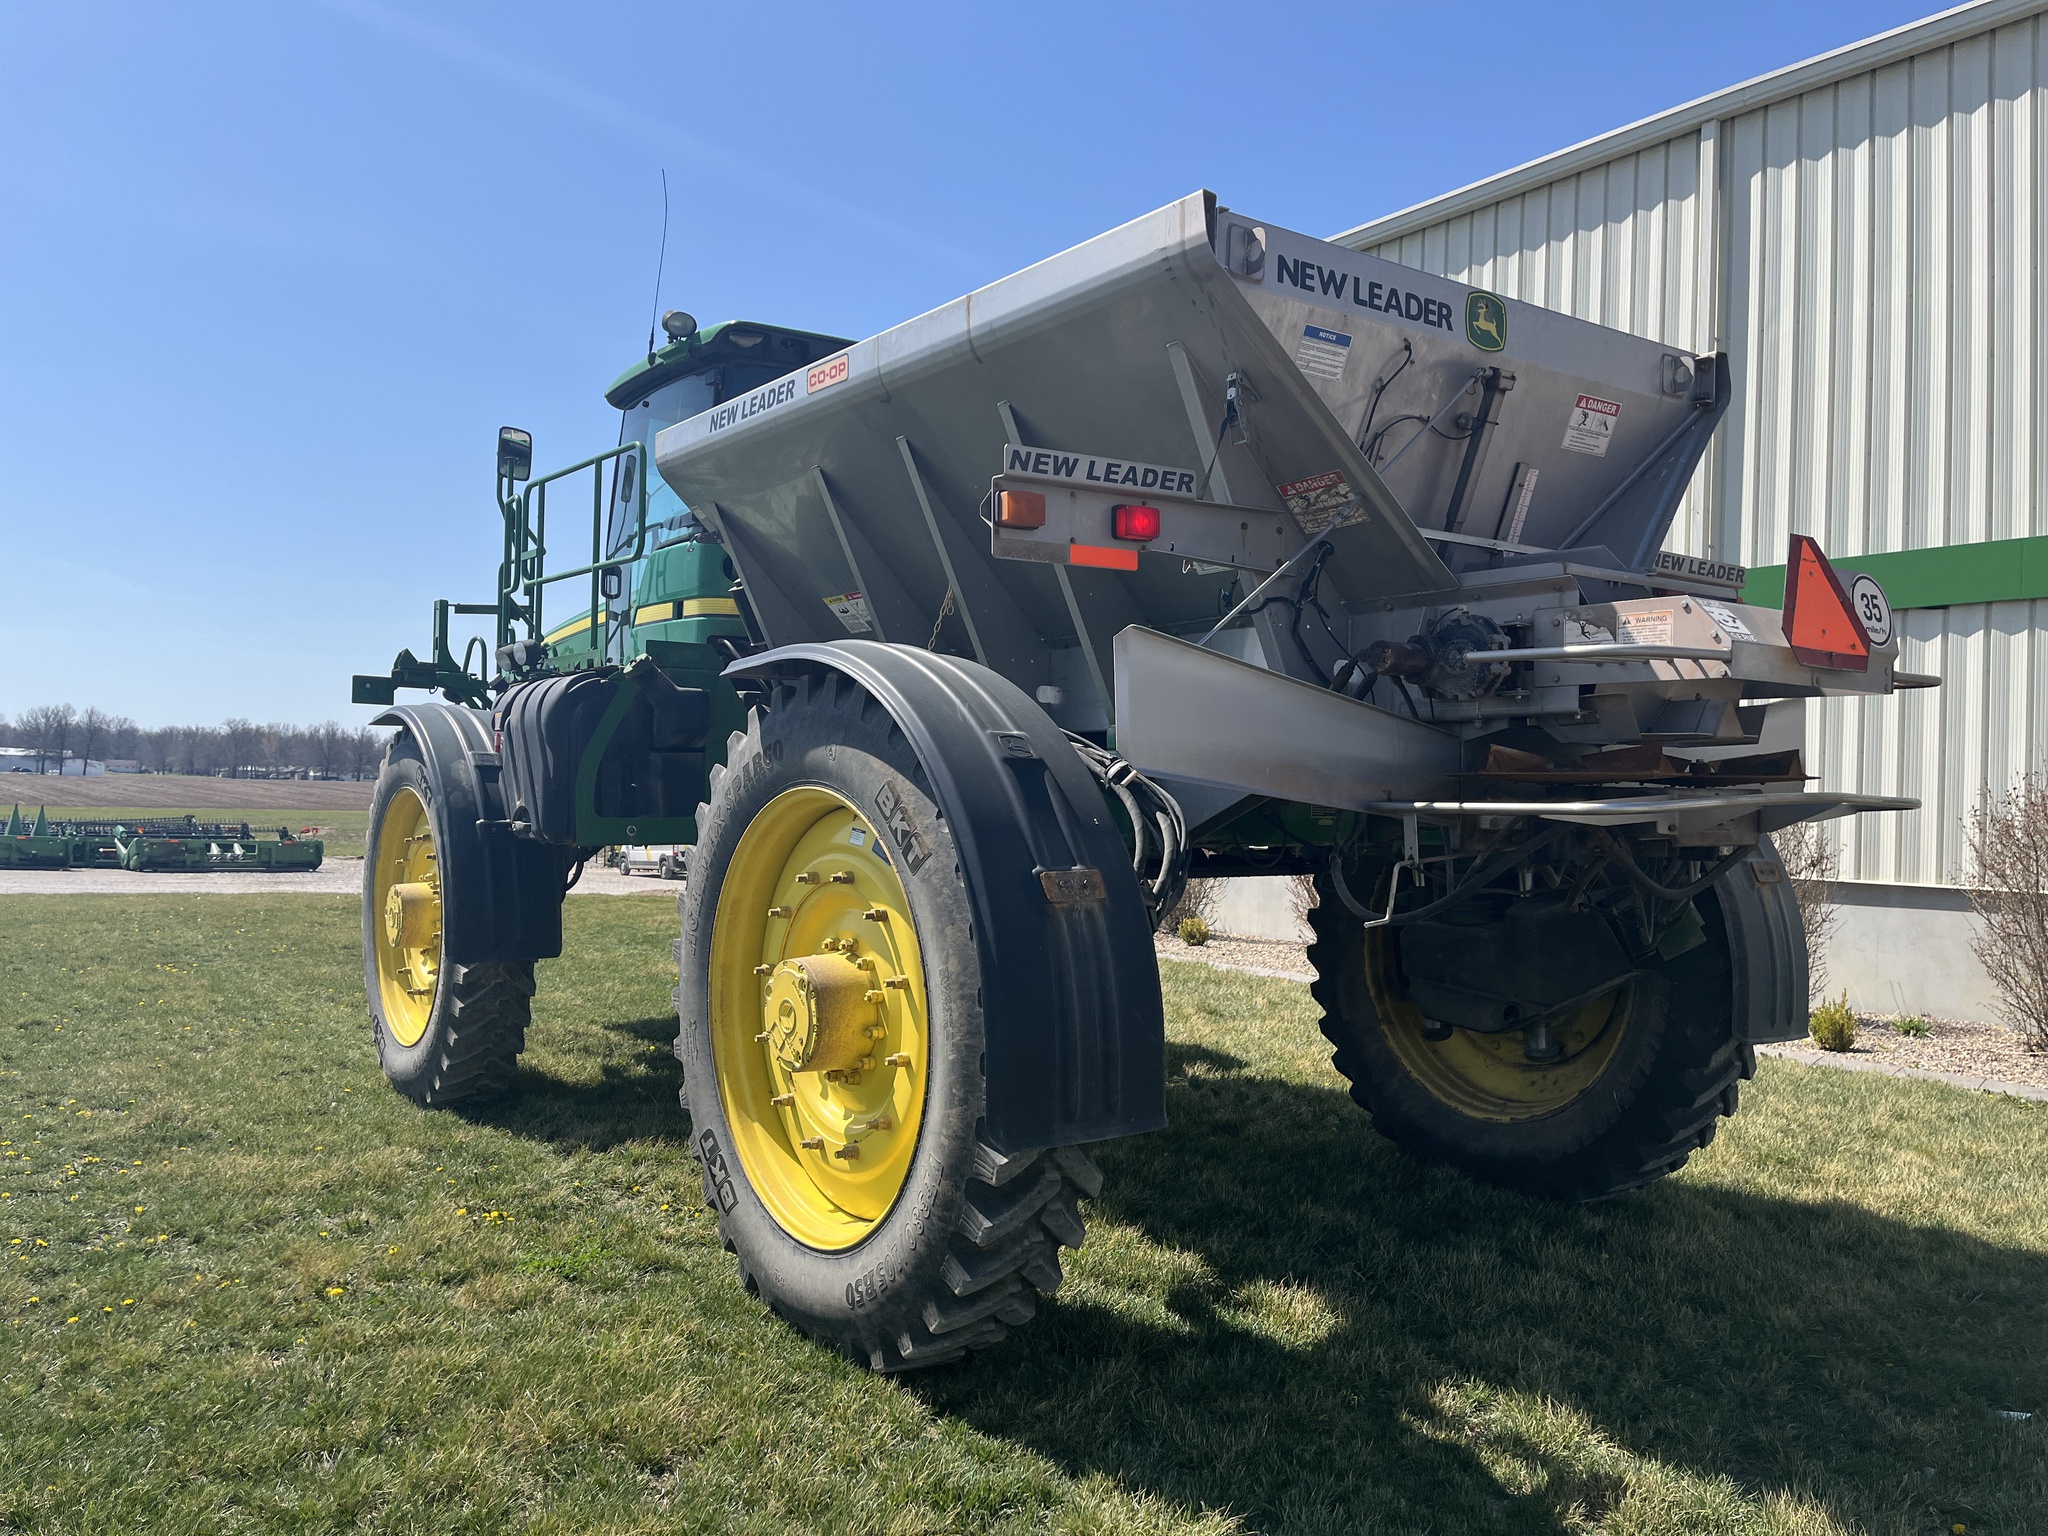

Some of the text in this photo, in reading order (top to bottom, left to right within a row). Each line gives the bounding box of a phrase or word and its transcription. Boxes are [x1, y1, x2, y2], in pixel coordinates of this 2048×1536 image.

[1277, 254, 1453, 332] NEW LEADER
[1319, 331, 1337, 340] NOTICE
[709, 379, 796, 433] NEW LEADER
[1587, 399, 1617, 415] DANGER
[1008, 449, 1195, 493] NEW LEADER
[1294, 473, 1339, 492] DANGER
[1687, 559, 1745, 584] LEADER
[1635, 614, 1668, 624] WARNING
[1860, 592, 1883, 623] 35
[1866, 626, 1887, 635] mile/h
[416, 765, 433, 809] BKT
[874, 779, 933, 876] BKT
[700, 1128, 739, 1216] BKT
